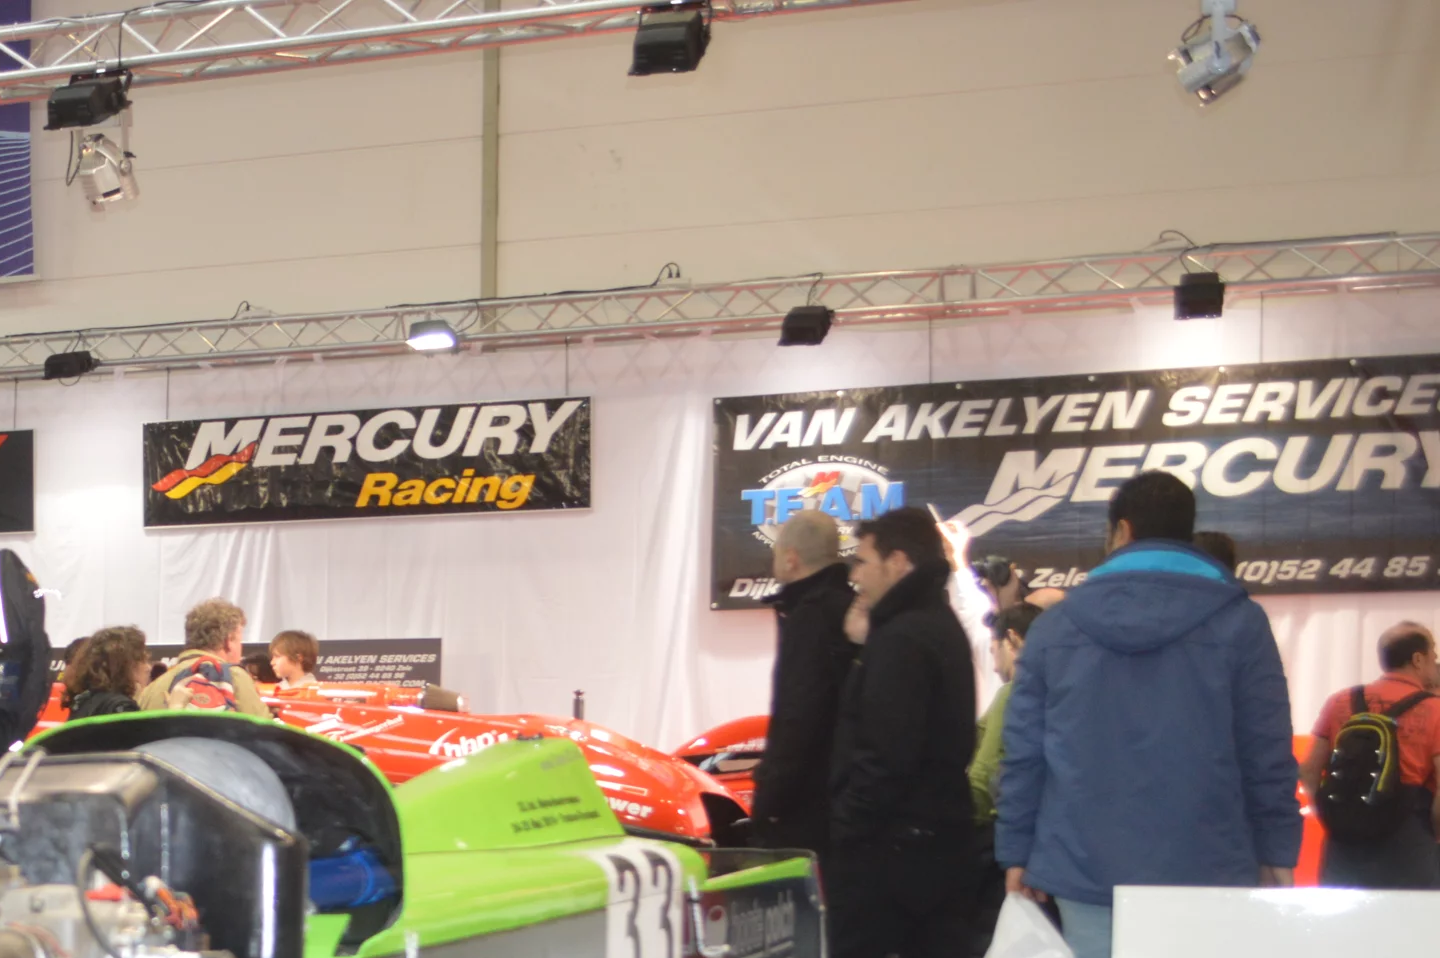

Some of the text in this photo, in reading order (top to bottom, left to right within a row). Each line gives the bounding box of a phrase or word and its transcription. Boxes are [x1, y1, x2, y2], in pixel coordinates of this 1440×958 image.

[184, 399, 585, 471] MERCURY
[732, 407, 857, 451] VAN
[861, 388, 1151, 444] AKELYEN
[758, 454, 890, 485] TOTAL ENGINE
[355, 468, 536, 510] Racing
[1027, 567, 1090, 588] Zele
[1329, 556, 1376, 579] 44
[1383, 555, 1430, 578] 85
[324, 654, 378, 665] AKELYEN
[378, 653, 437, 664] SERVICES
